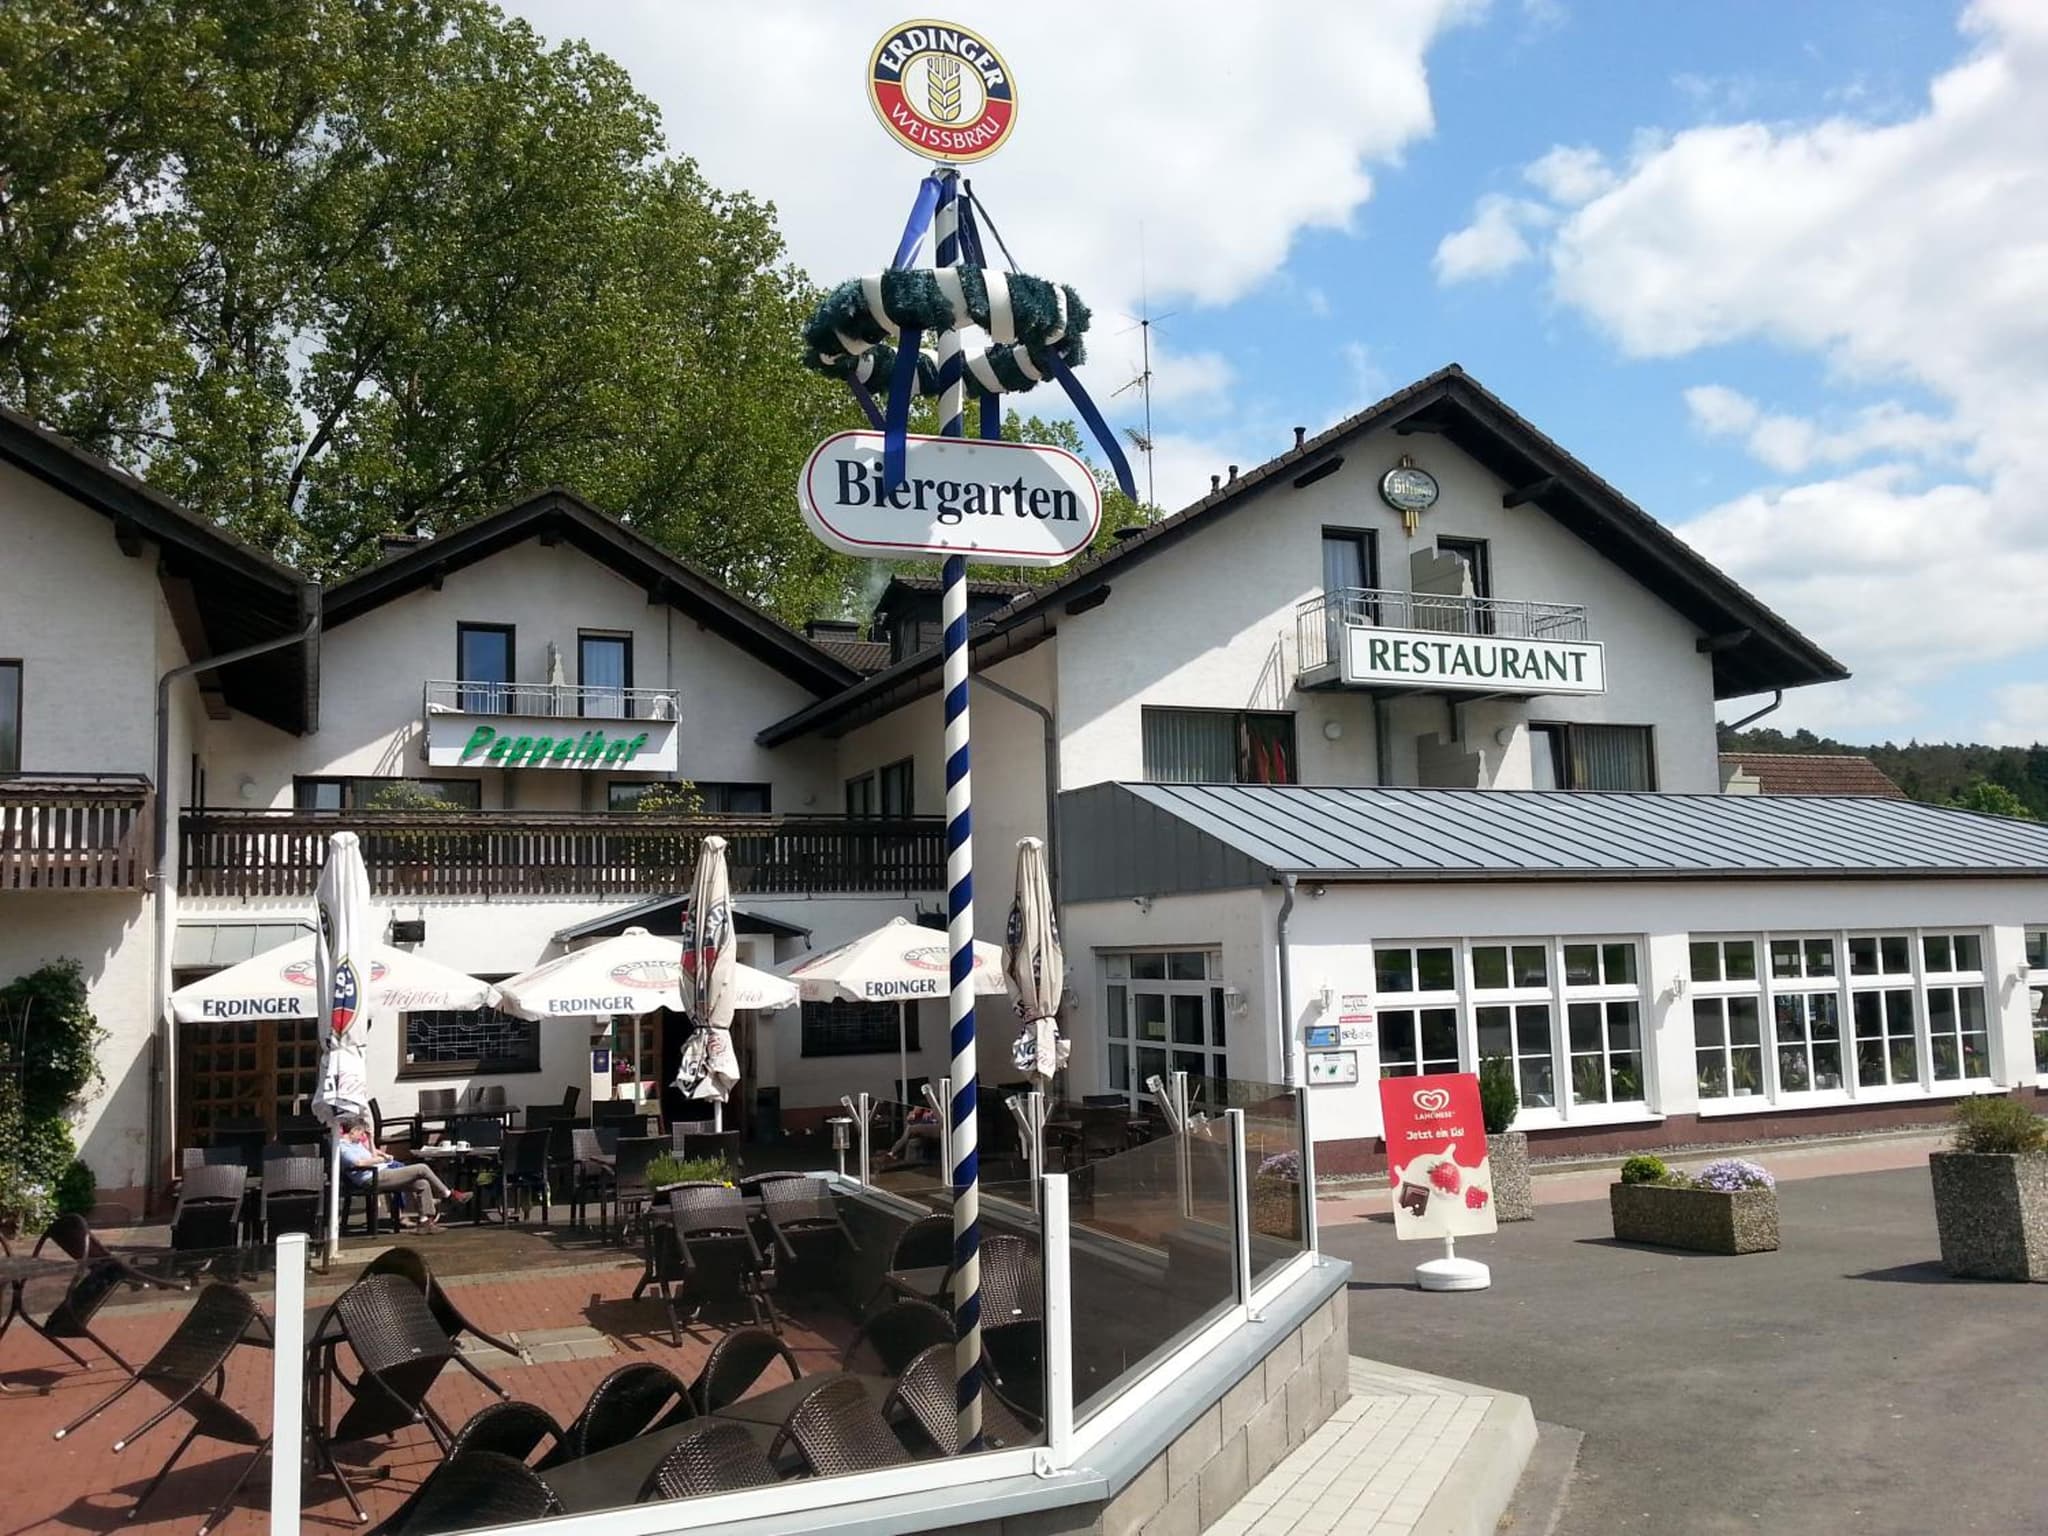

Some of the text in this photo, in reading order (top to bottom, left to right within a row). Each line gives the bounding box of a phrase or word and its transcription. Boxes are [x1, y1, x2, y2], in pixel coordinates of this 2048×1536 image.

[879, 27, 1005, 89] ERDINGER
[891, 102, 1001, 149] WEISSBRÄU
[835, 459, 1079, 525] Biergarten
[1368, 637, 1588, 682] RESTAURANT
[460, 725, 649, 767] Pappelhof
[202, 997, 302, 1018] ERDINGER
[549, 996, 635, 1014] ERDINGER
[866, 978, 937, 997] ERDINGER
